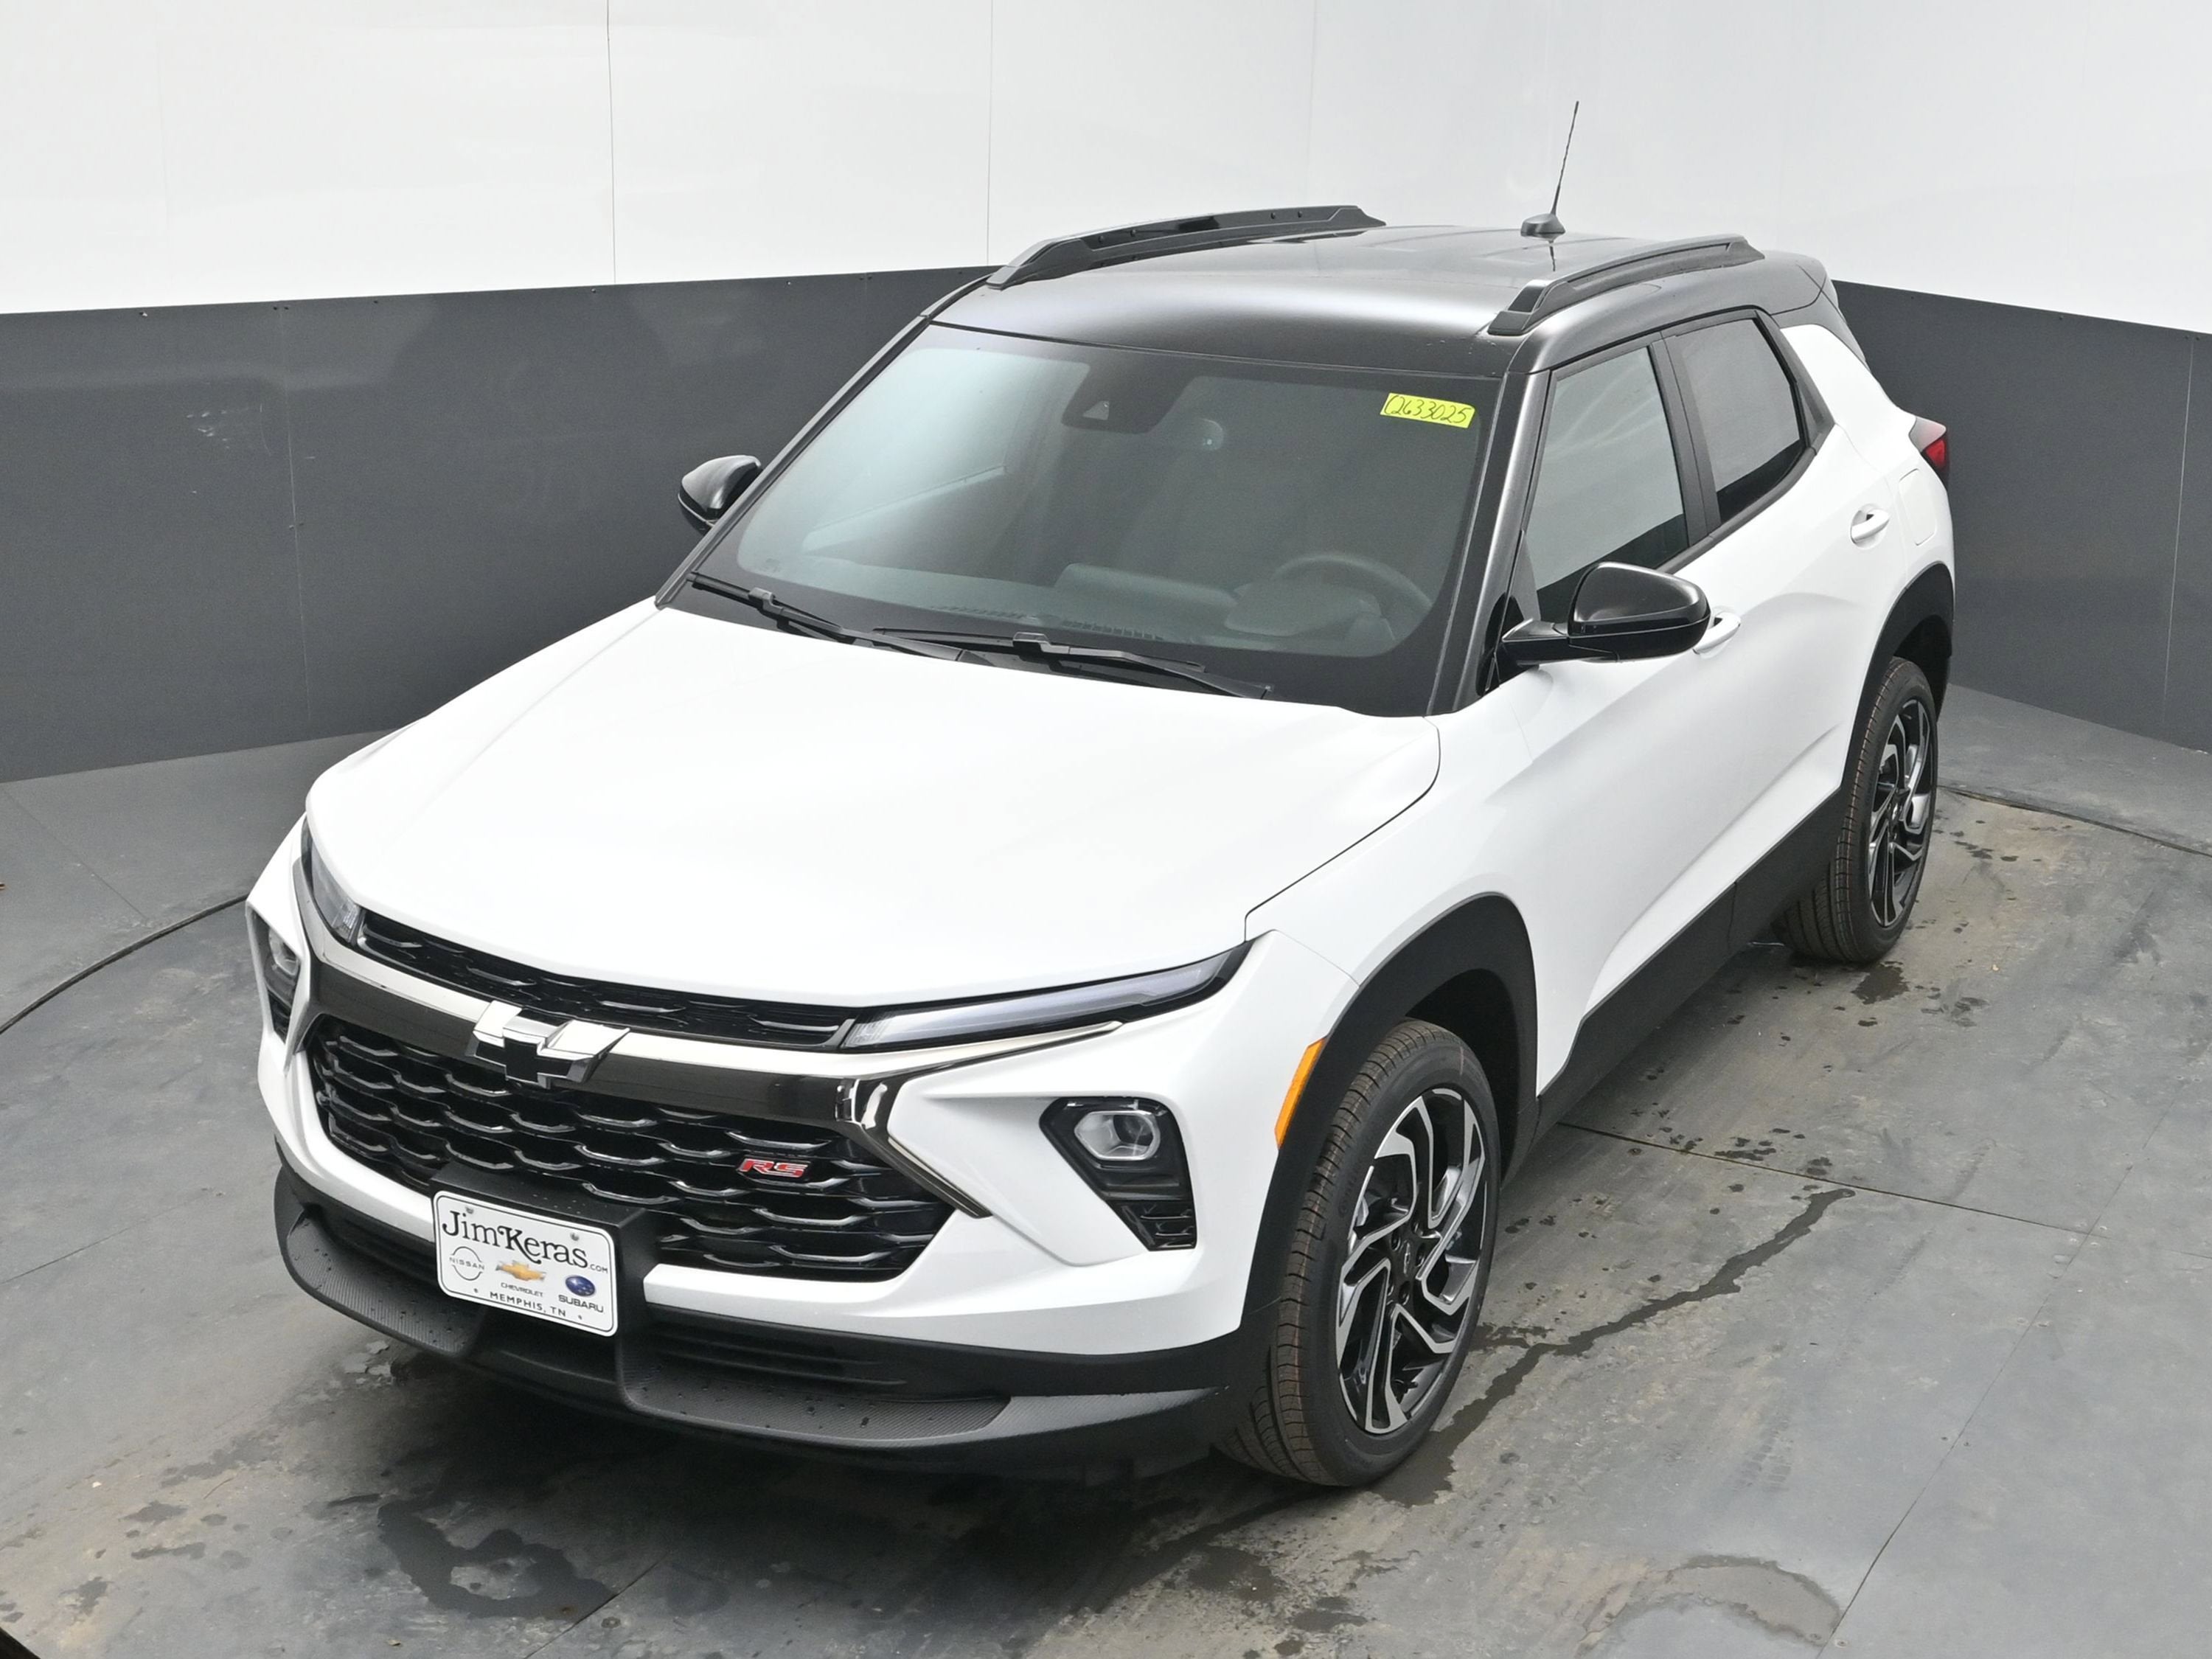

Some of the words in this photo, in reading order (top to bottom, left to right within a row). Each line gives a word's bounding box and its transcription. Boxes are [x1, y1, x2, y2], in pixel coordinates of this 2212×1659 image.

[738, 1158, 808, 1178] RS
[449, 1256, 485, 1271] NISSAN
[500, 1281, 544, 1298] CHEVROLET
[489, 1290, 546, 1313] MEMPHIS,
[550, 1306, 566, 1318] TN
[557, 1294, 604, 1313] SUBARU
